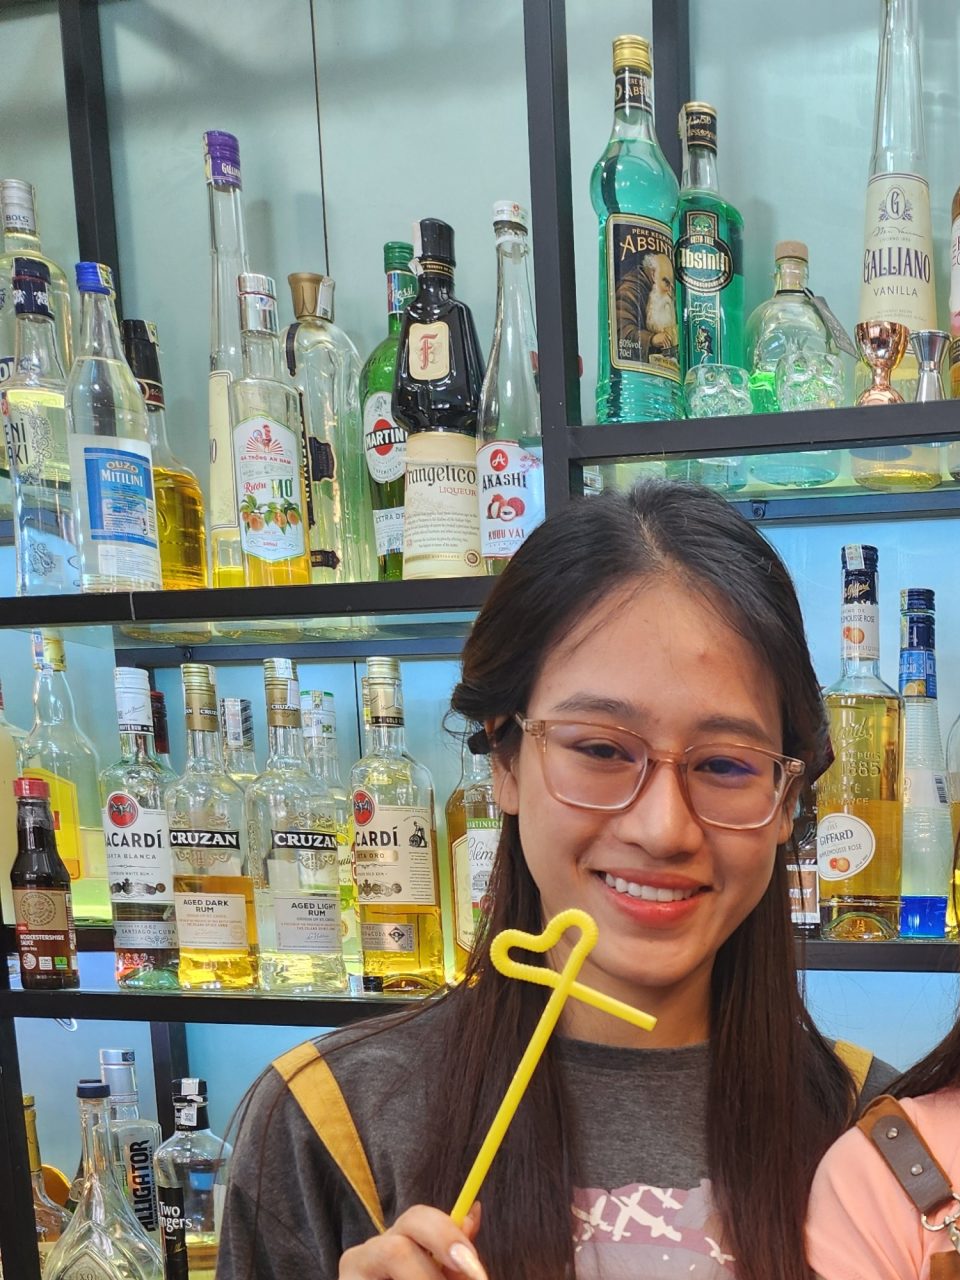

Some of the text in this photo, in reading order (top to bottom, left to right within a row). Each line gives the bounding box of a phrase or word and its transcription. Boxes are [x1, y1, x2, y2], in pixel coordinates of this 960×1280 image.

[5, 213, 30, 223] BOLS
[863, 246, 931, 285] GALLIANO
[873, 285, 919, 298] VANILLA
[106, 460, 139, 474] OUZO
[101, 468, 144, 488] MITILINI
[170, 831, 237, 846] CRUZAN
[819, 829, 854, 846] GIFFARD
[183, 899, 230, 907] AGED DARK
[291, 902, 316, 910] AGED
[307, 909, 326, 917] RUM
[159, 1201, 181, 1218] Two
